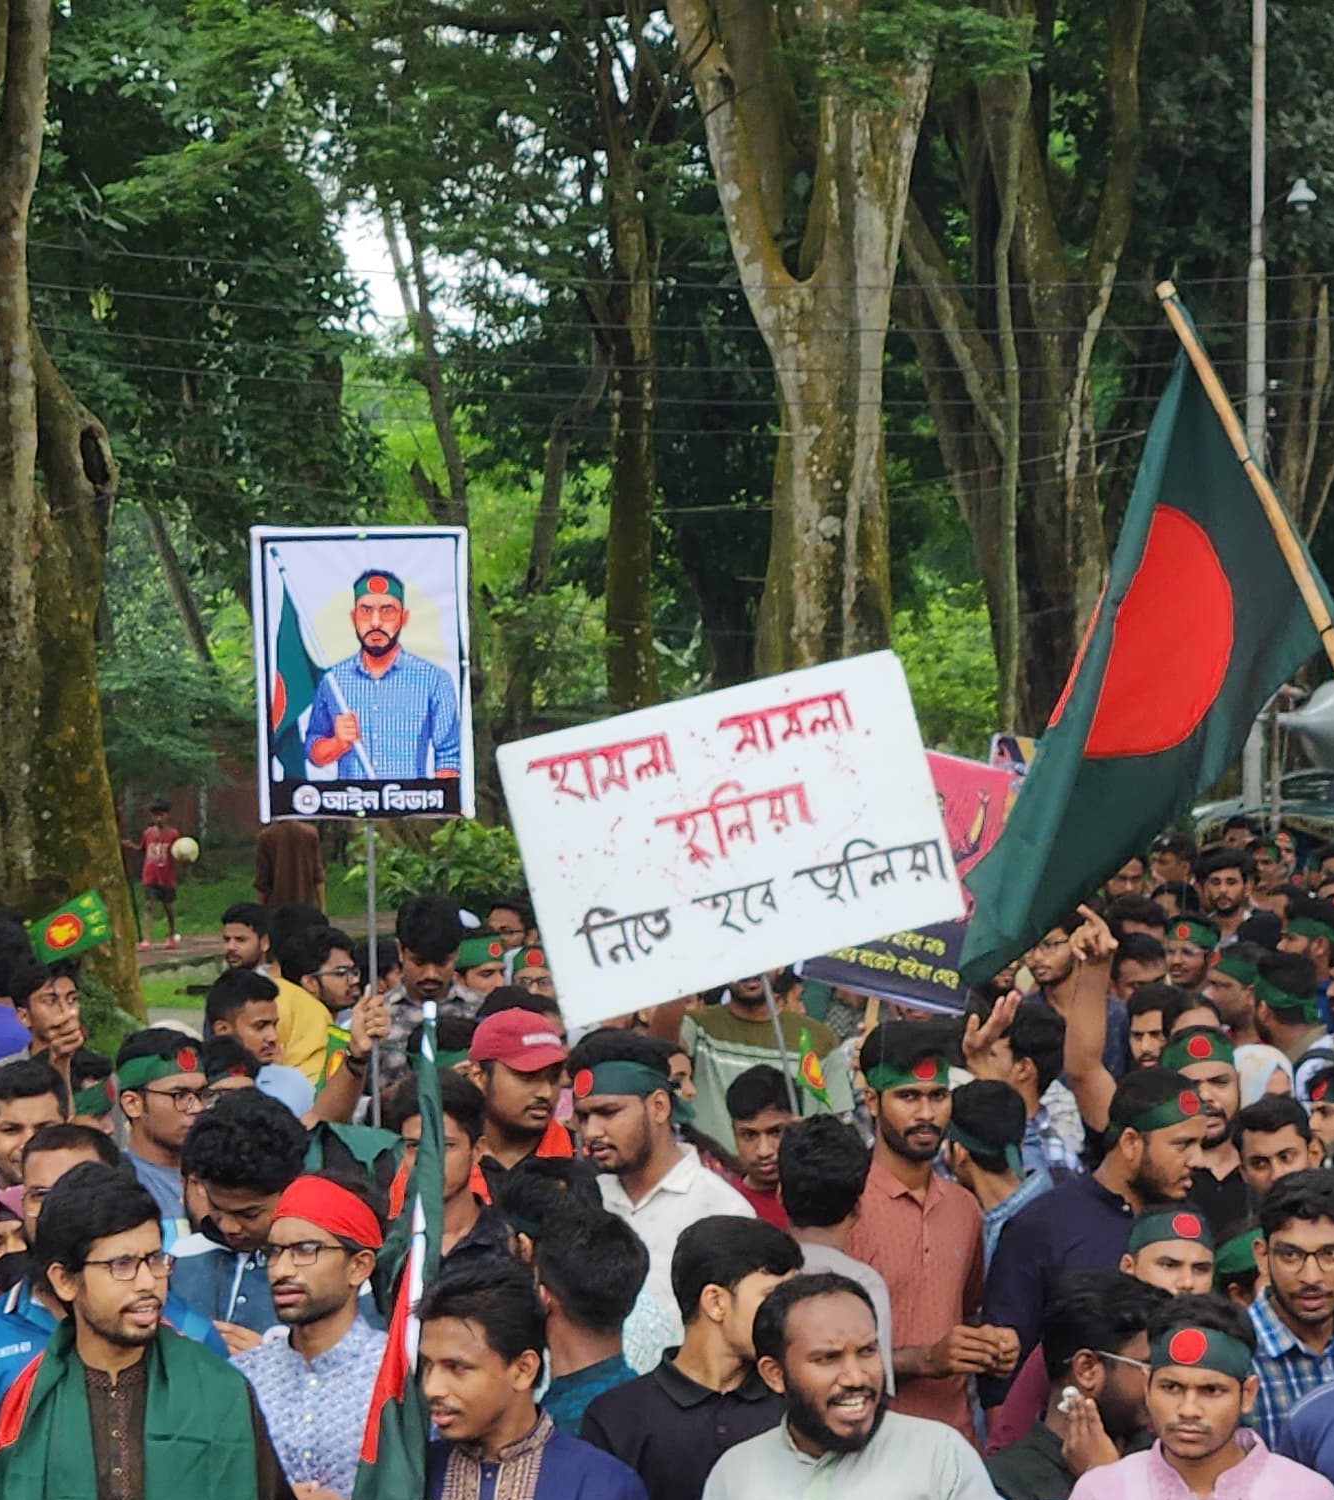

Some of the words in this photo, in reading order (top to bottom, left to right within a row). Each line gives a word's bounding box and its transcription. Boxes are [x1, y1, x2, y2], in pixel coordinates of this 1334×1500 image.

[526, 731, 677, 802] হামলা
[717, 689, 854, 753] মামলা
[321, 785, 380, 811] আইন
[382, 783, 445, 811] বিভাগ
[654, 780, 816, 869] হুলিয়া
[573, 905, 672, 968] নিতে
[691, 878, 780, 934] হবে
